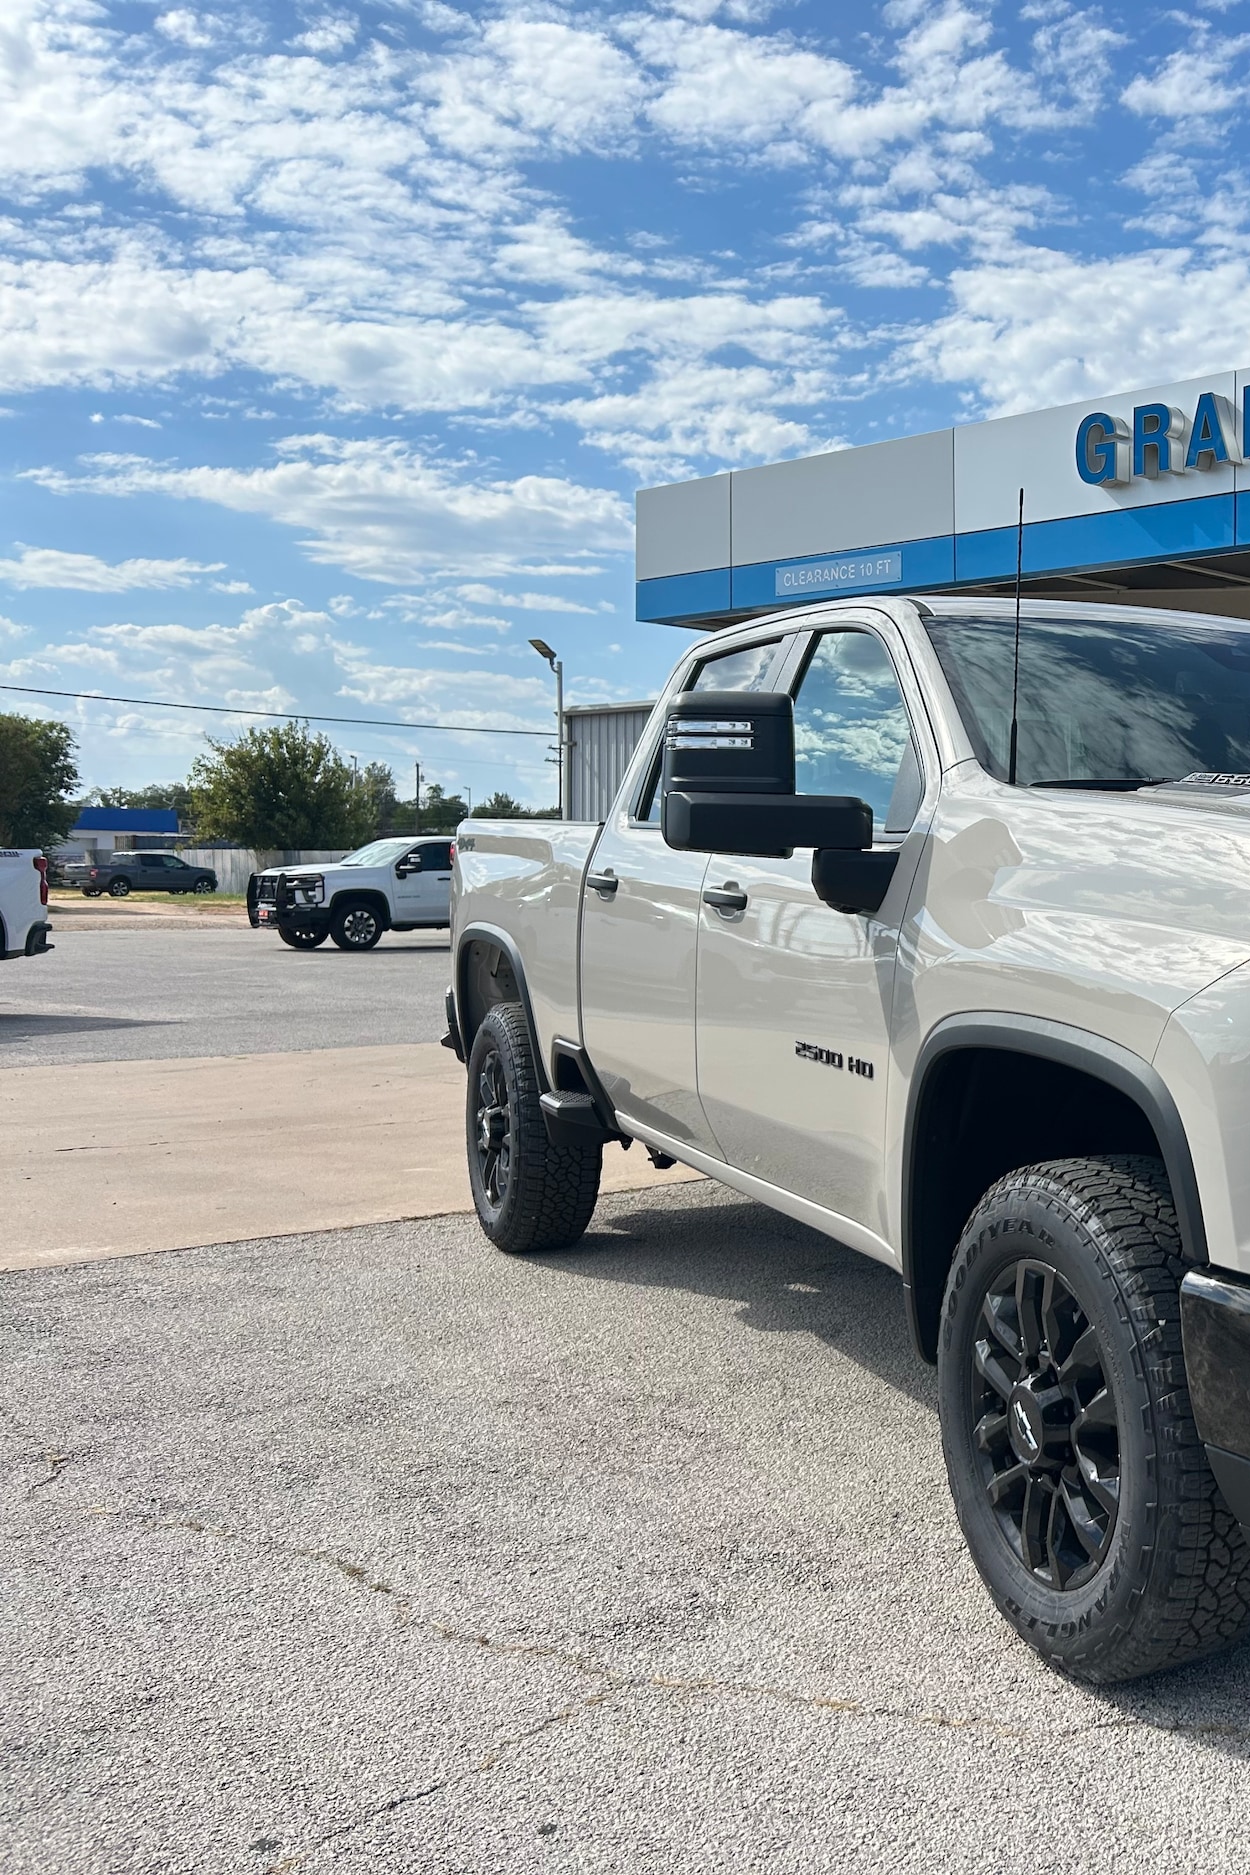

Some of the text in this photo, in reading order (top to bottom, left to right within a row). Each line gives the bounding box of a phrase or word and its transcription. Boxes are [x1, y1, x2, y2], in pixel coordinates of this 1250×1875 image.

[783, 560, 891, 587] CLEARANCE 10 FT
[795, 1040, 874, 1080] 2500 HD
[943, 1216, 1056, 1350] GOODYEAR
